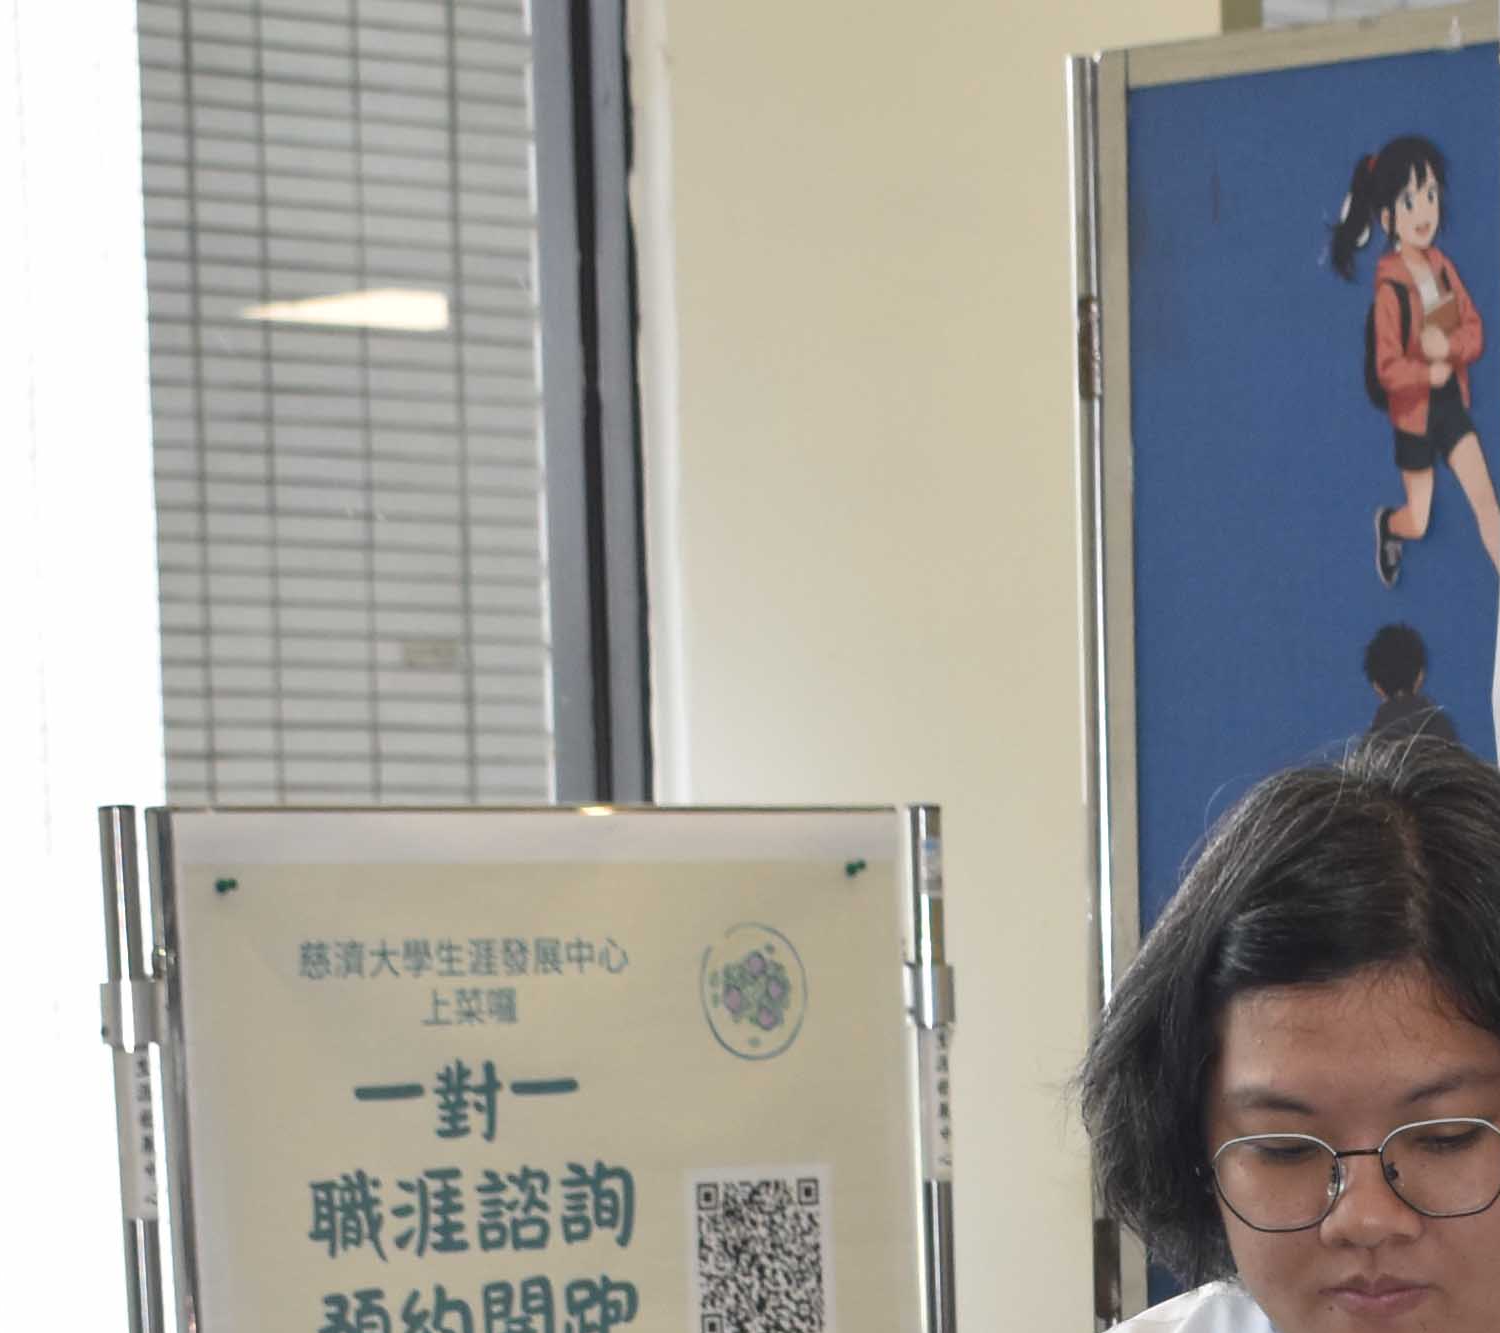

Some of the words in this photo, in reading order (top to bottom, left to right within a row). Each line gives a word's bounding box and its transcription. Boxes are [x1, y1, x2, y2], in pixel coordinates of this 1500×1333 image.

[299, 936, 629, 981] 慈濟大學生涯發展中心
[353, 1060, 580, 1142] 一對一
[309, 1161, 638, 1262] 職涯諮詢
